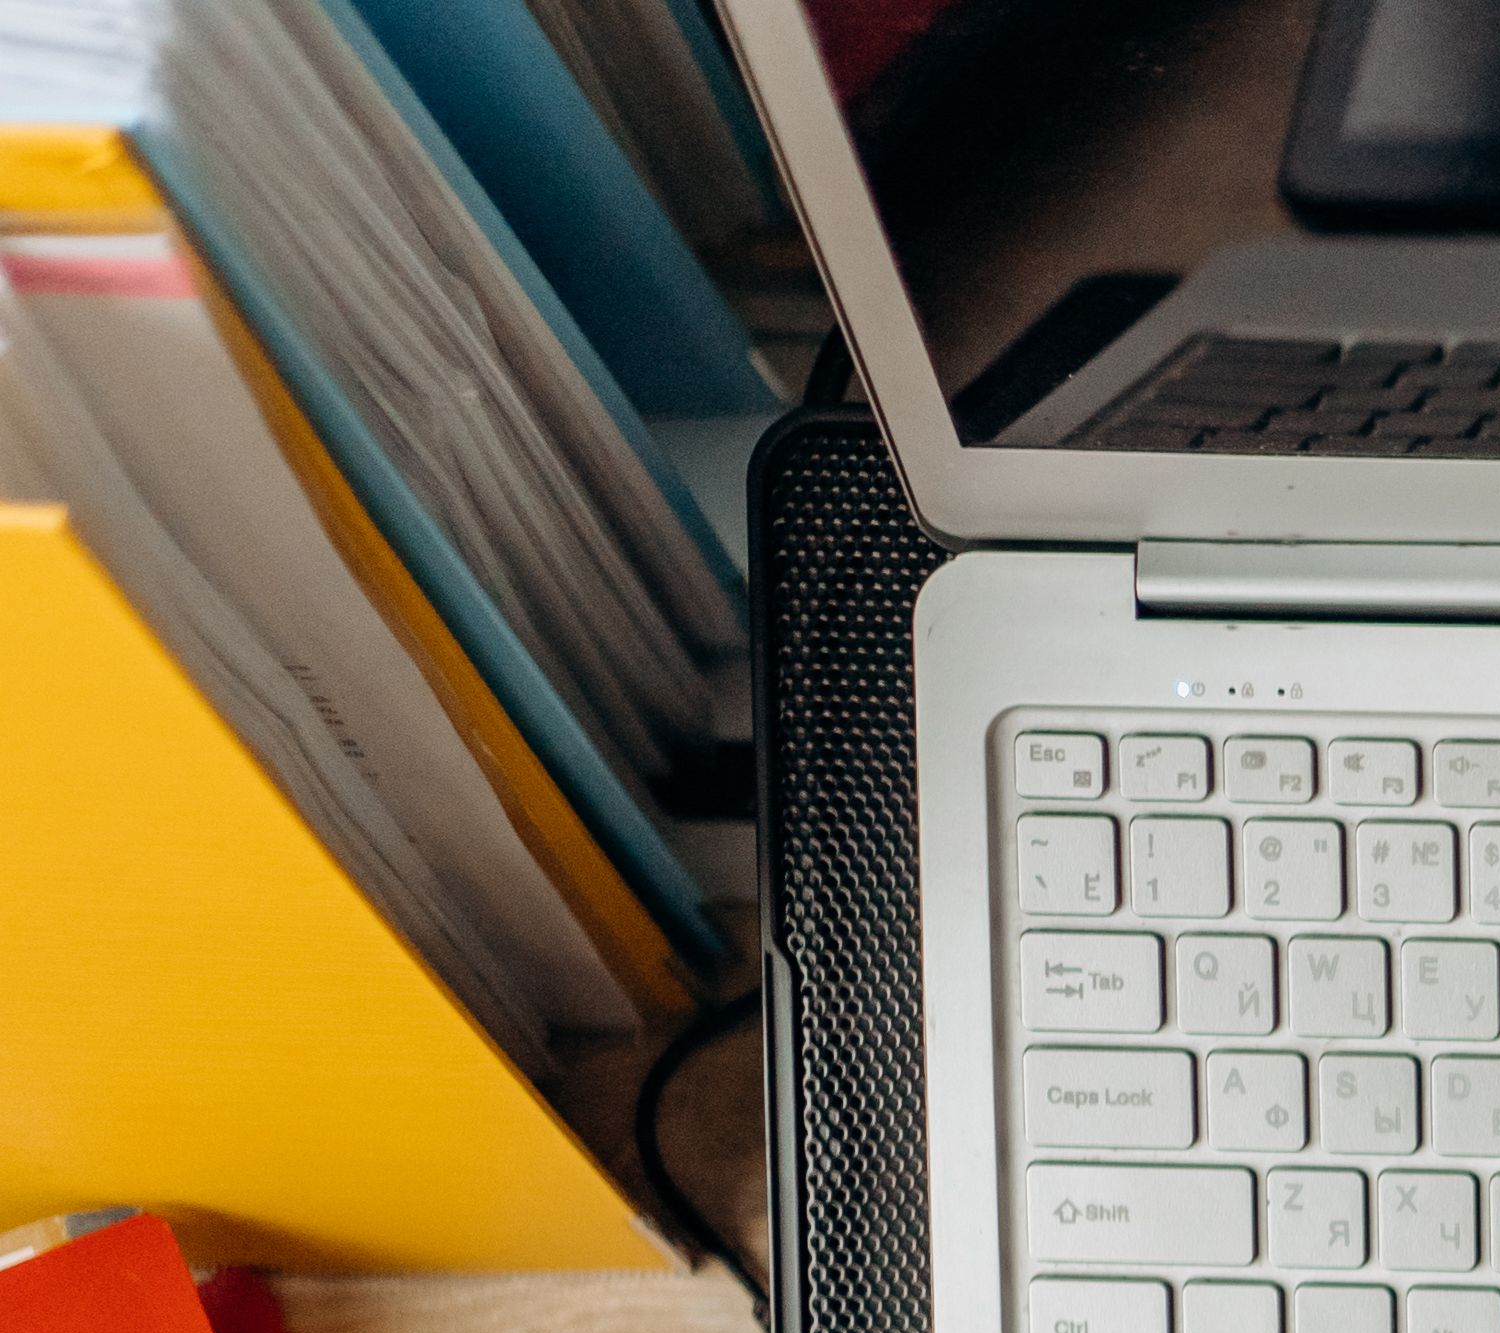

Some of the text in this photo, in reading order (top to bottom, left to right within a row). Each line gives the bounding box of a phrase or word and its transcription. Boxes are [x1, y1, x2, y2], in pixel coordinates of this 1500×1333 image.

[1029, 743, 1067, 764] Esc
[1176, 772, 1197, 790] F1
[1278, 773, 1303, 793] F2
[1381, 776, 1404, 795] F3
[1258, 835, 1283, 862] @
[1371, 839, 1391, 865] #
[1483, 841, 1500, 868] $
[1145, 876, 1160, 903] 1
[1262, 879, 1281, 906] 2
[1372, 882, 1392, 908] 3
[1192, 951, 1220, 982] Q
[1307, 953, 1341, 983] W
[1417, 955, 1440, 986] E
[1087, 970, 1126, 992] Tab
[1237, 980, 1260, 1018] Й
[1351, 991, 1376, 1026] Ц
[1222, 1066, 1247, 1095] A
[1334, 1069, 1359, 1100] S
[1446, 1072, 1472, 1101] D
[1045, 1084, 1154, 1109] Caps Lock
[1264, 1102, 1290, 1130] Ф
[1373, 1105, 1401, 1135] Ы
[1282, 1182, 1305, 1213] Z
[1395, 1184, 1419, 1215] X
[1084, 1203, 1131, 1224] Shift
[1327, 1219, 1350, 1248] Я
[1439, 1221, 1461, 1250] Ч
